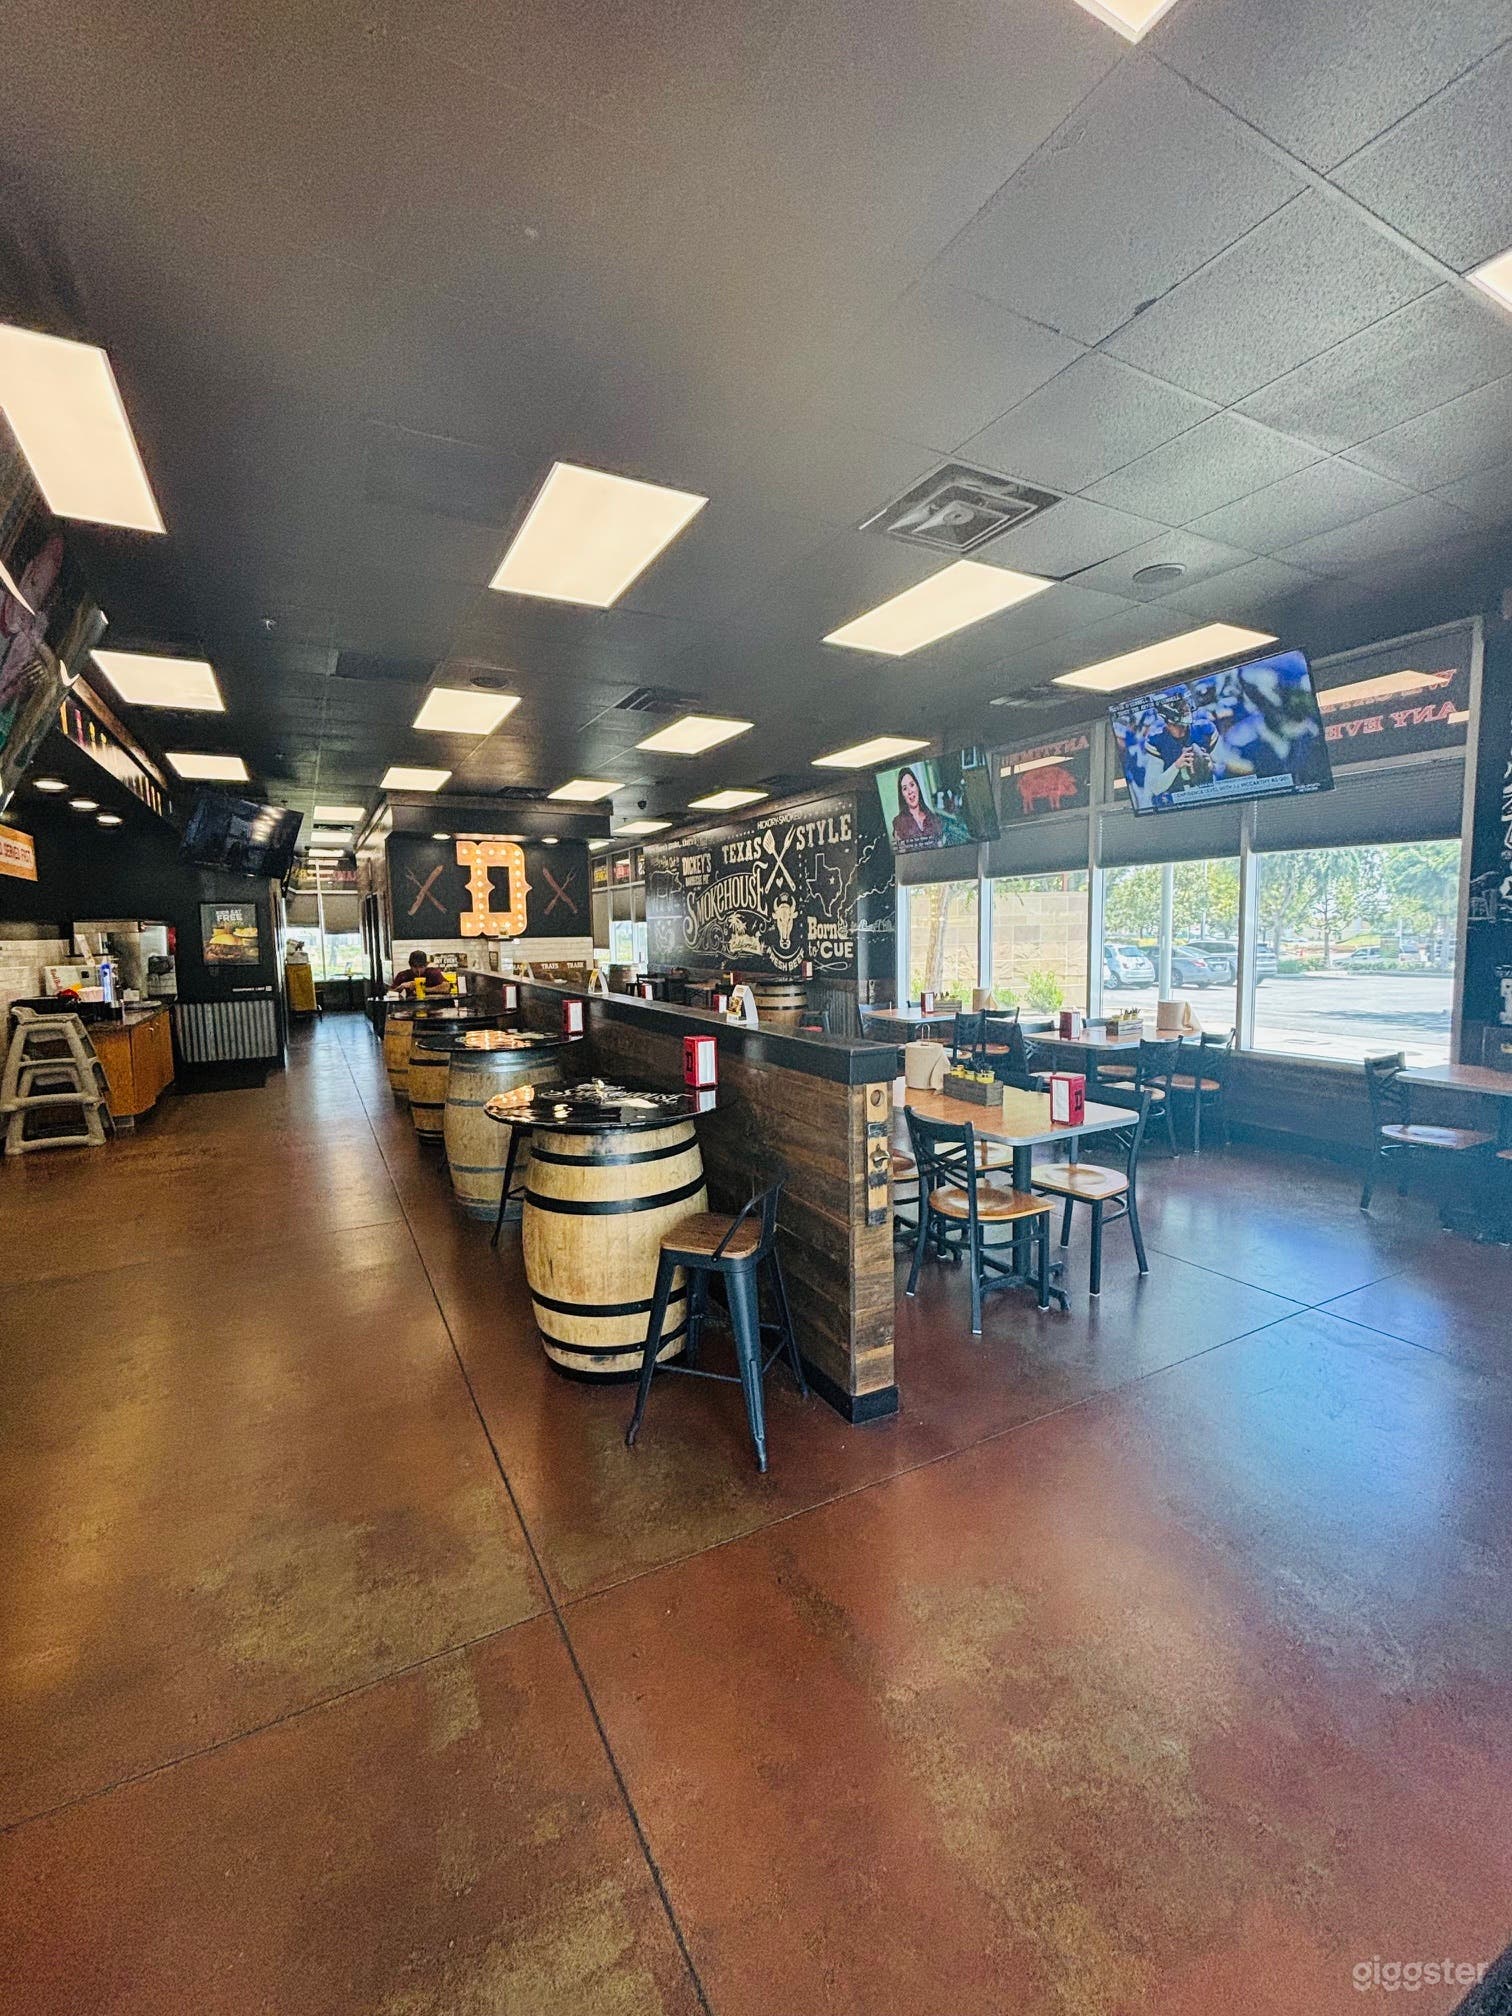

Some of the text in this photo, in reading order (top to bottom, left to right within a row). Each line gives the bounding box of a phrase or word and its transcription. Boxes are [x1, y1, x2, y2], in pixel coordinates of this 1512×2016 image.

[722, 837, 762, 864] TEXAS
[796, 813, 851, 851] STYLE
[456, 841, 532, 936] D
[682, 853, 712, 876] DICKEY'S
[683, 861, 769, 948] SMOKEHOUSE
[807, 916, 838, 940] Born
